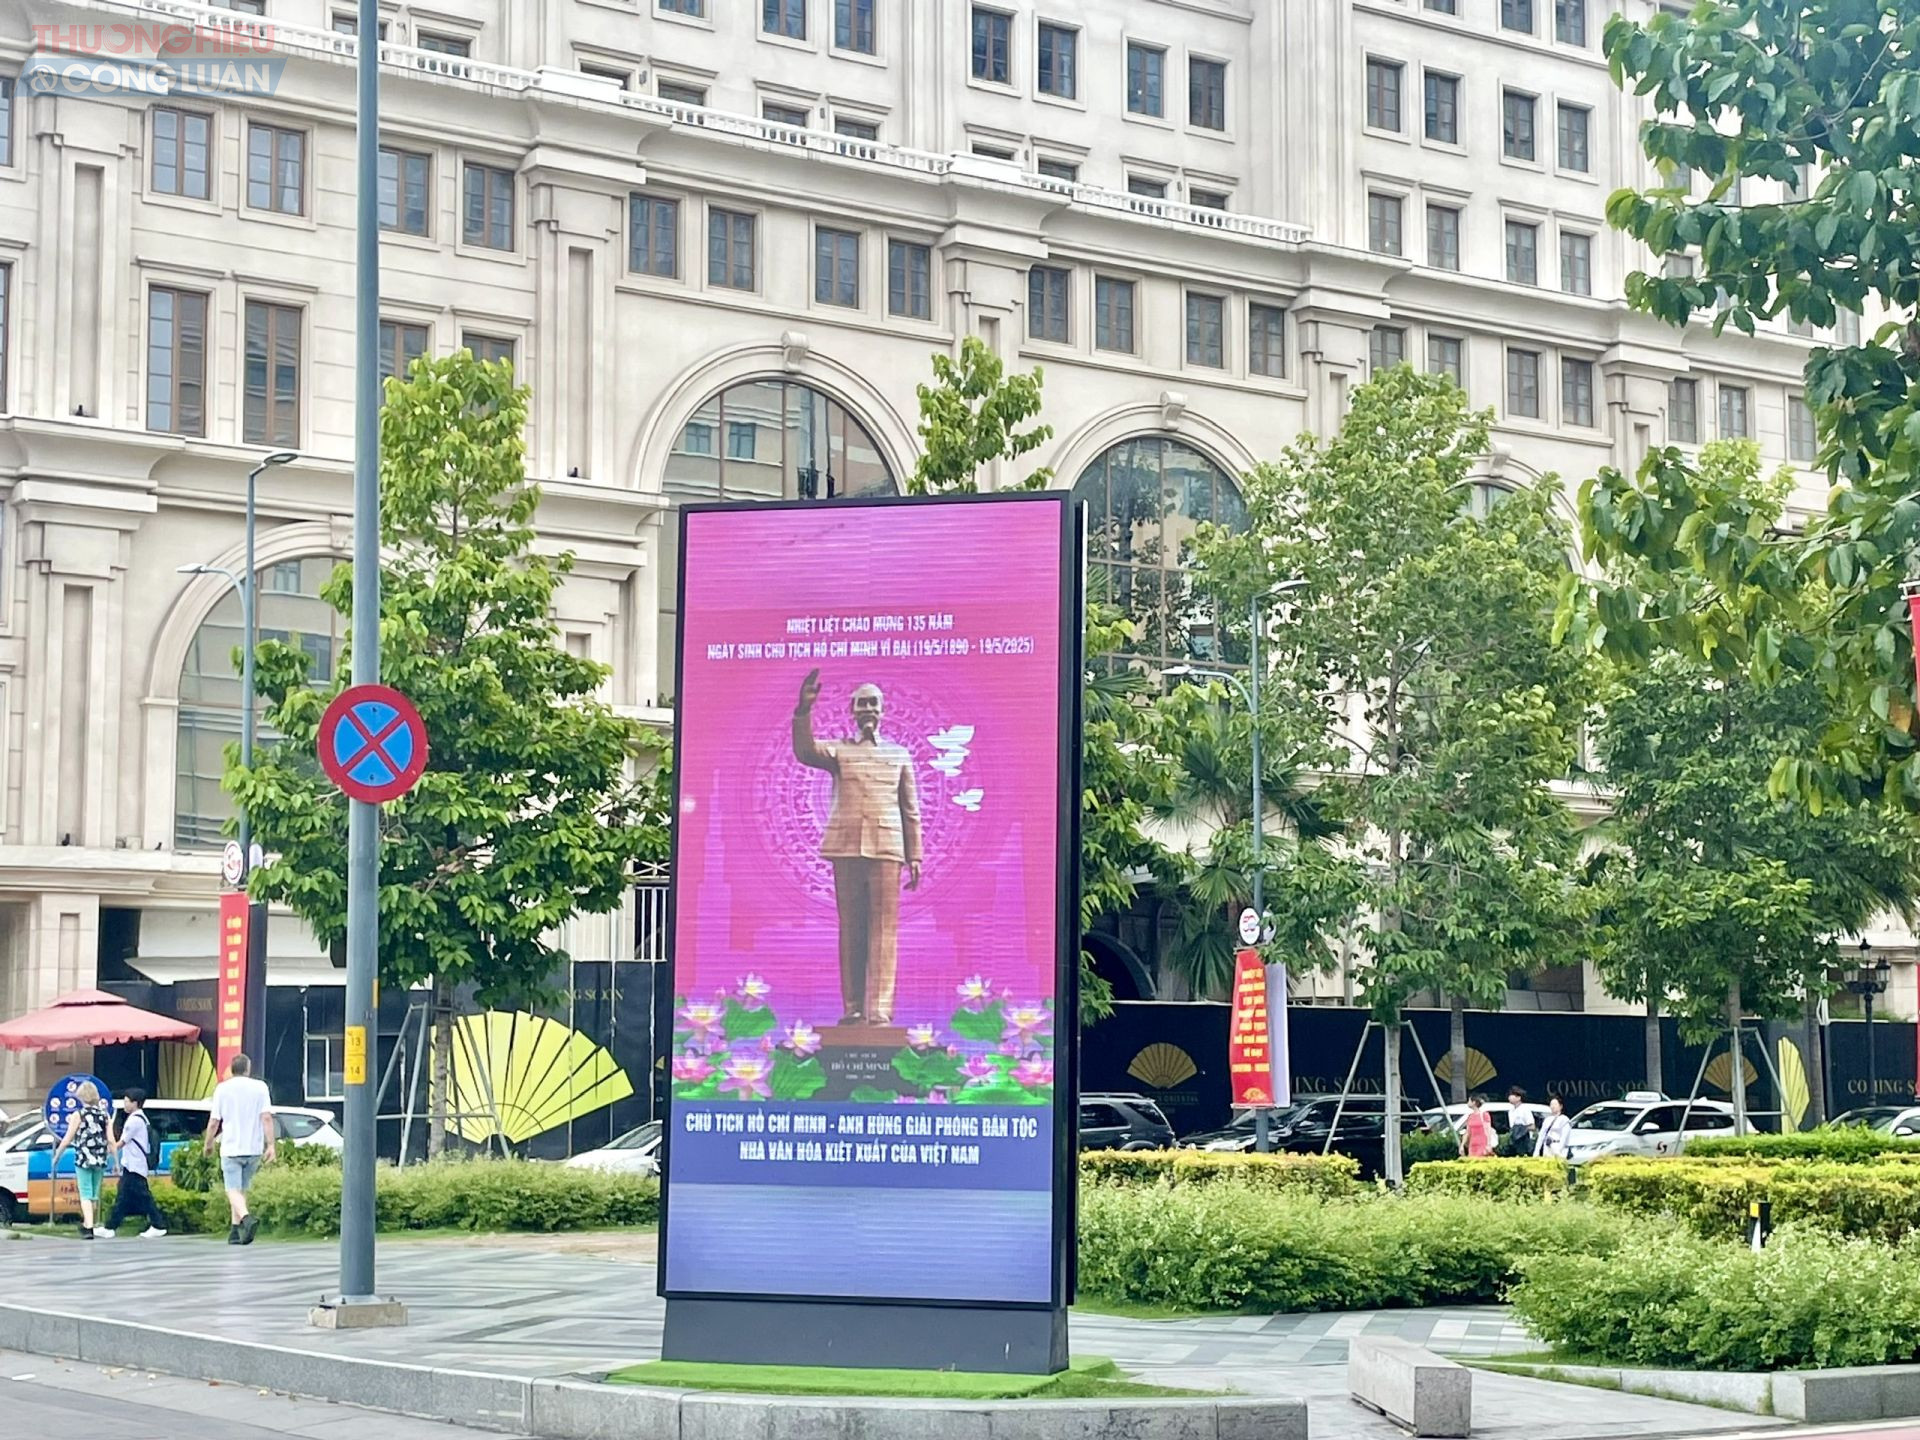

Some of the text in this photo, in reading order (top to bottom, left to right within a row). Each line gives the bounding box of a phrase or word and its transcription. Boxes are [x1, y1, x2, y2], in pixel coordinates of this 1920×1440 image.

[818, 614, 839, 636] LIỆT
[907, 615, 926, 632] 135
[738, 643, 762, 659] SINH
[788, 642, 810, 661] TỊCH
[850, 640, 878, 657] MINH
[351, 1036, 361, 1047] 13
[350, 1065, 361, 1076] 14
[1546, 1079, 1612, 1098] COMING
[685, 1108, 712, 1132] CHỦ
[715, 1112, 744, 1136] TỊCH
[793, 1115, 827, 1134] MINH
[838, 1115, 863, 1134] ANH
[867, 1113, 902, 1135] HÙNG
[1011, 1114, 1038, 1140] TỘC
[740, 1139, 765, 1160] NHÀ
[796, 1140, 822, 1161] HÓA
[825, 1140, 853, 1164] KIỆT
[855, 1137, 888, 1162] XUẤT
[890, 1140, 917, 1163] CỦA
[920, 1141, 947, 1167] VIỆT
[950, 1145, 980, 1164] NAM
